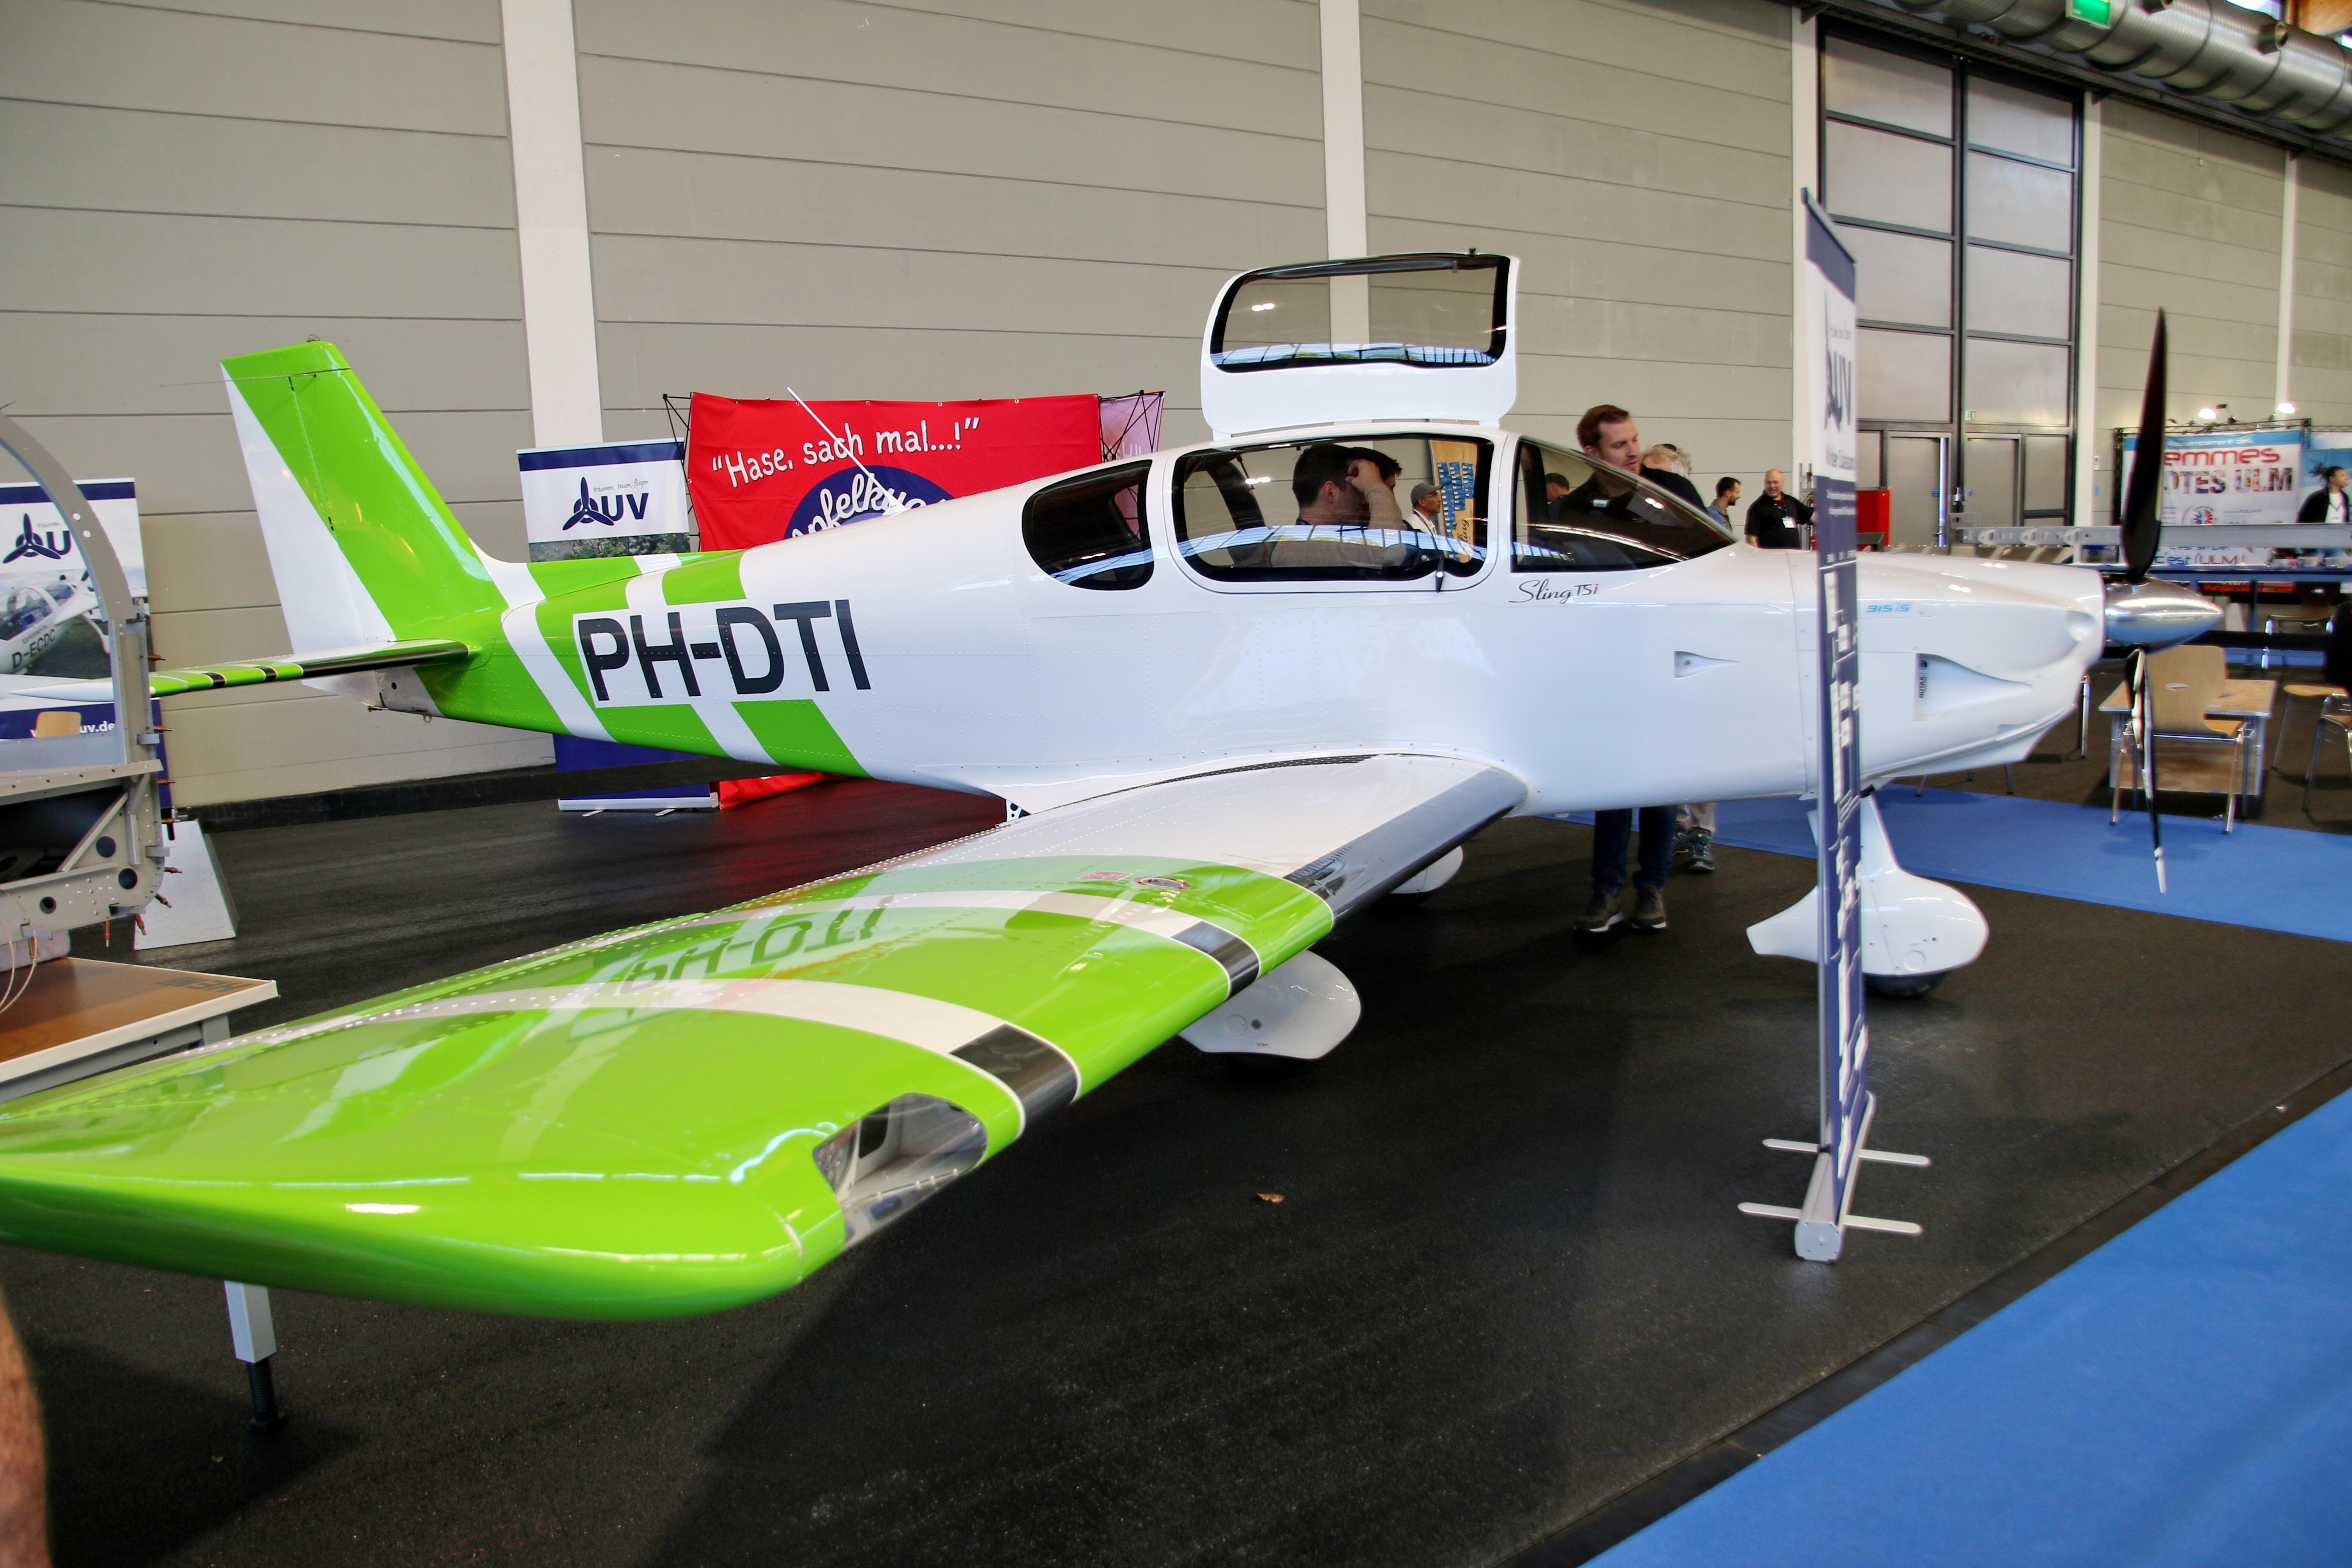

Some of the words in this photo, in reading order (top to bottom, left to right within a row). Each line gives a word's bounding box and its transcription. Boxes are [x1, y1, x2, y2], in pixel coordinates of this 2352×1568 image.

[803, 423, 864, 464] sach
[2163, 448, 2280, 466] emmes
[2235, 467, 2292, 493] ULM
[1509, 578, 1571, 604] Sling
[1574, 584, 1599, 596] TSi
[578, 600, 872, 701] PH-DTI
